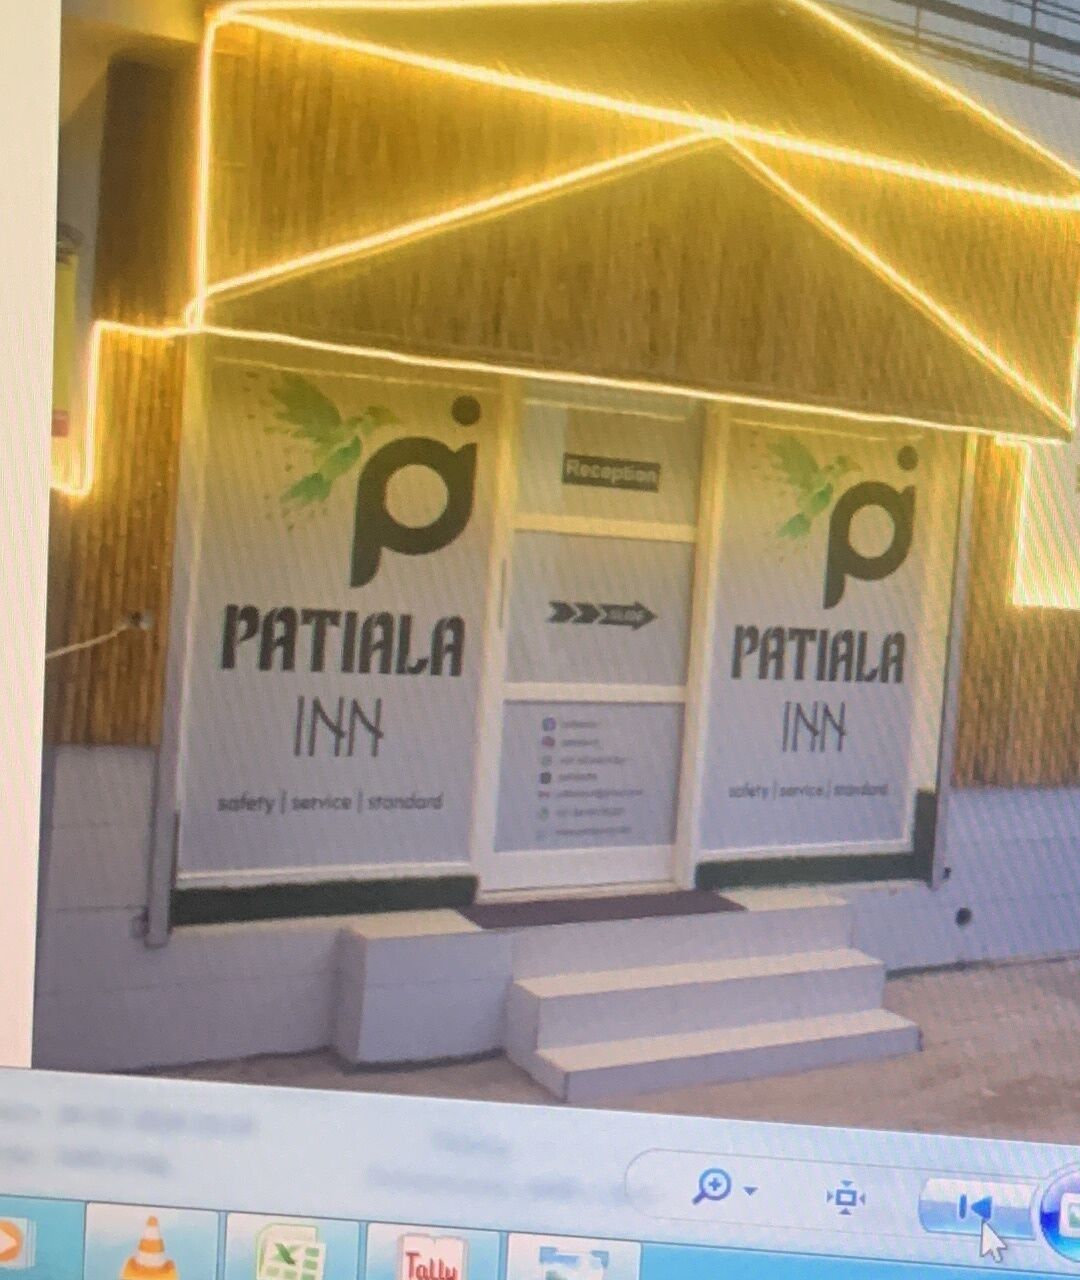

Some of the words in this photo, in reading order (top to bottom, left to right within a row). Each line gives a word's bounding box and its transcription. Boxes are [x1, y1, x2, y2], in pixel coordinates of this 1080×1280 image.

[565, 458, 660, 485] Reception
[220, 604, 465, 677] PATIALA
[731, 625, 907, 684] PATIALA
[293, 695, 385, 758] INN
[782, 701, 848, 753] INN
[217, 791, 276, 815] safety
[291, 794, 352, 811] service
[367, 790, 444, 811] standard
